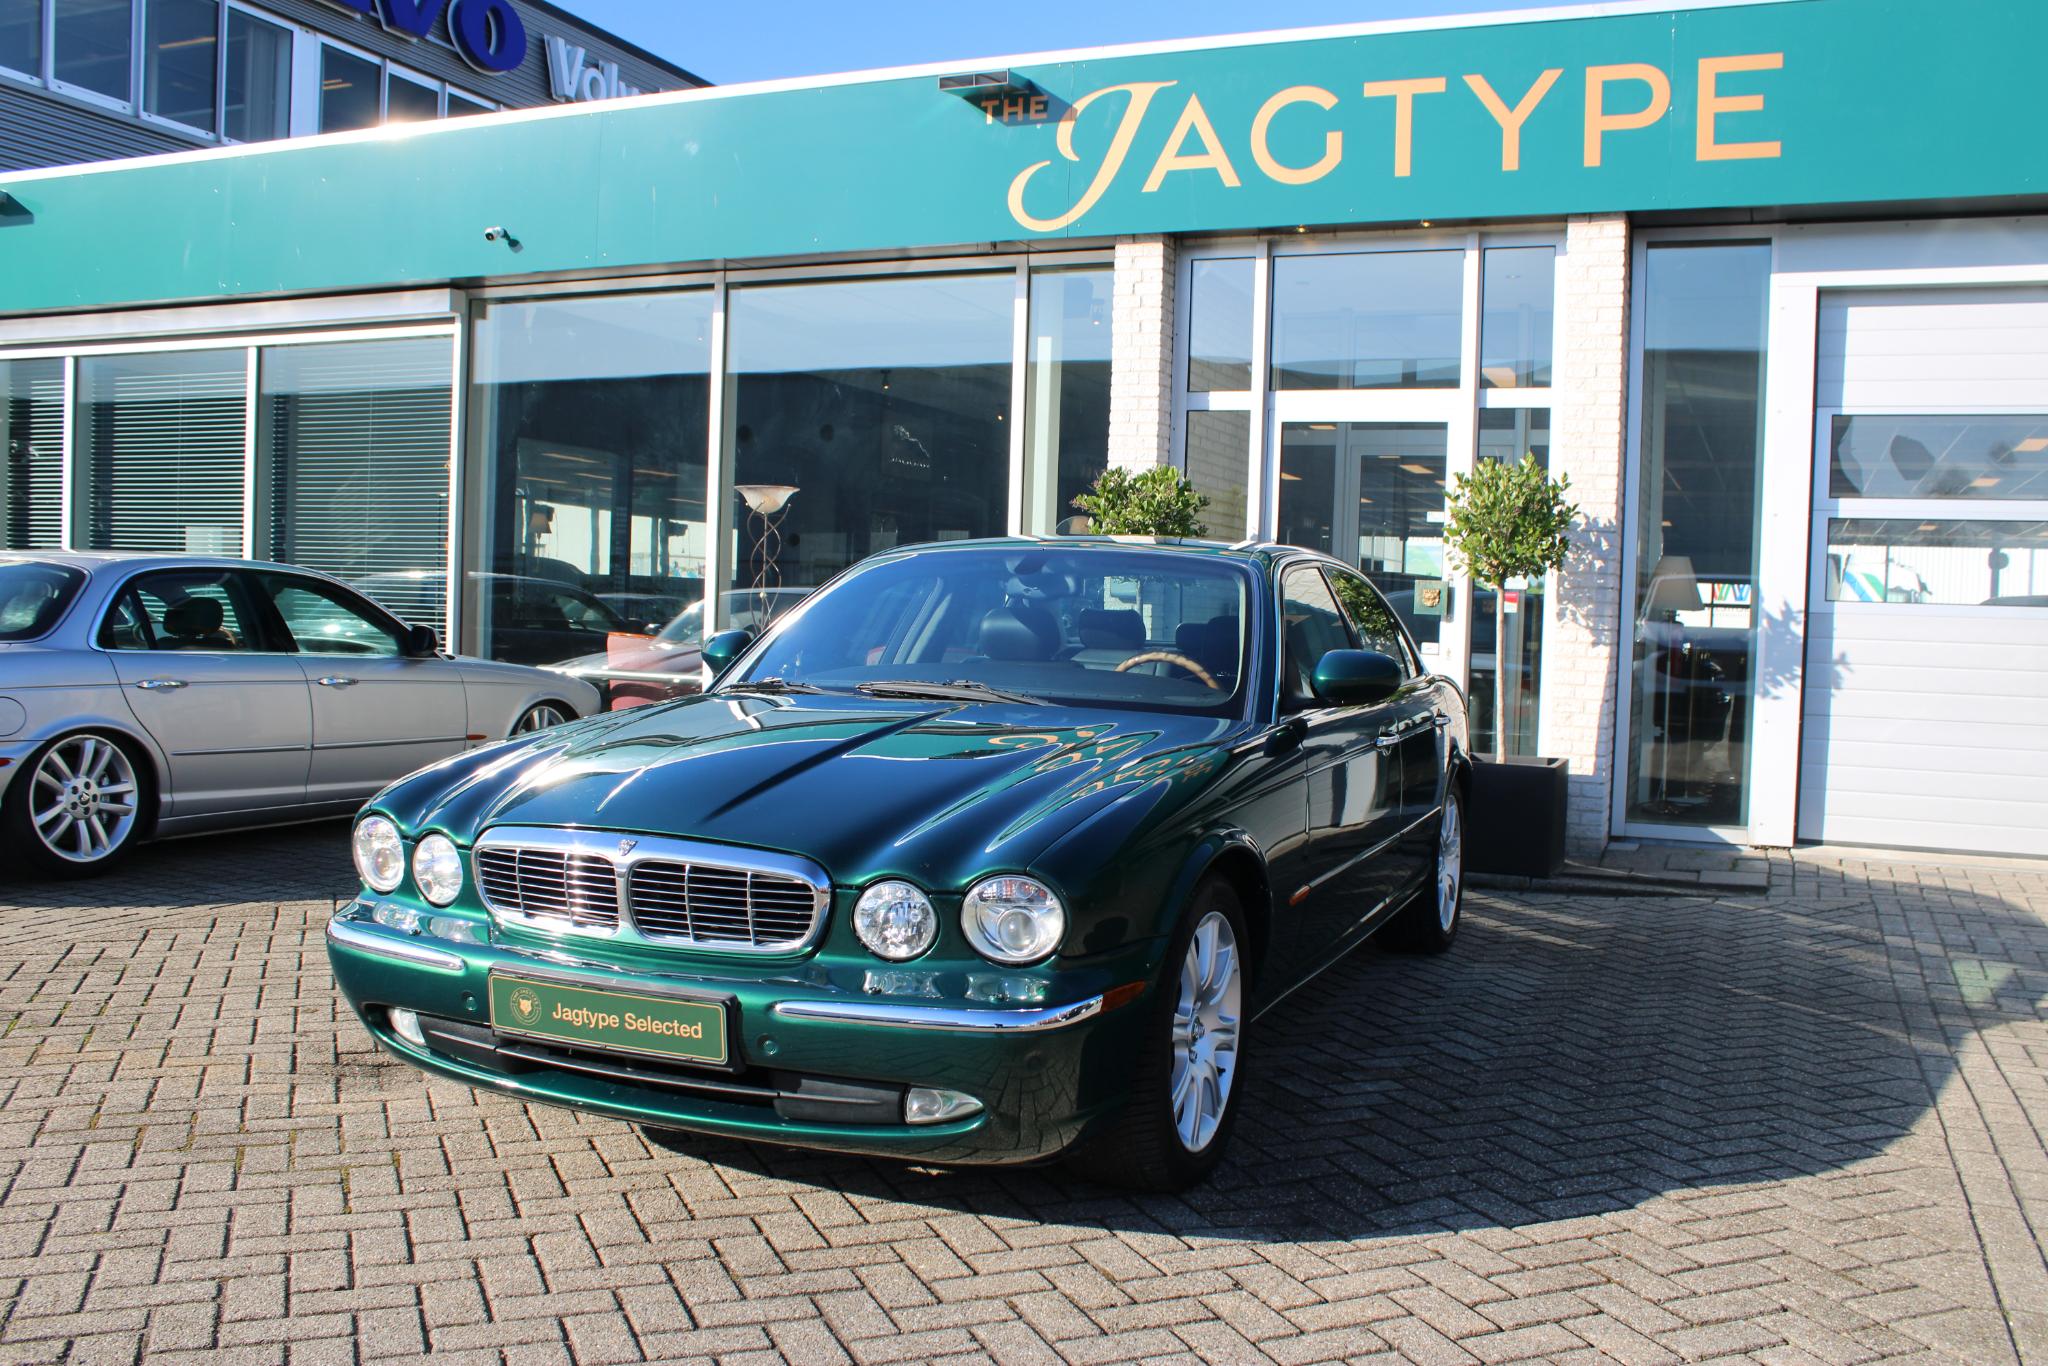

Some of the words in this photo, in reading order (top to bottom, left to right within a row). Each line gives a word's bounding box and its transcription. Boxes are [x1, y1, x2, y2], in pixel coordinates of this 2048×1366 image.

[980, 95, 1049, 125] THE
[1007, 52, 1784, 232] JAGTYPE
[552, 1002, 620, 1030] Jagtype
[624, 1012, 703, 1040] Selected
